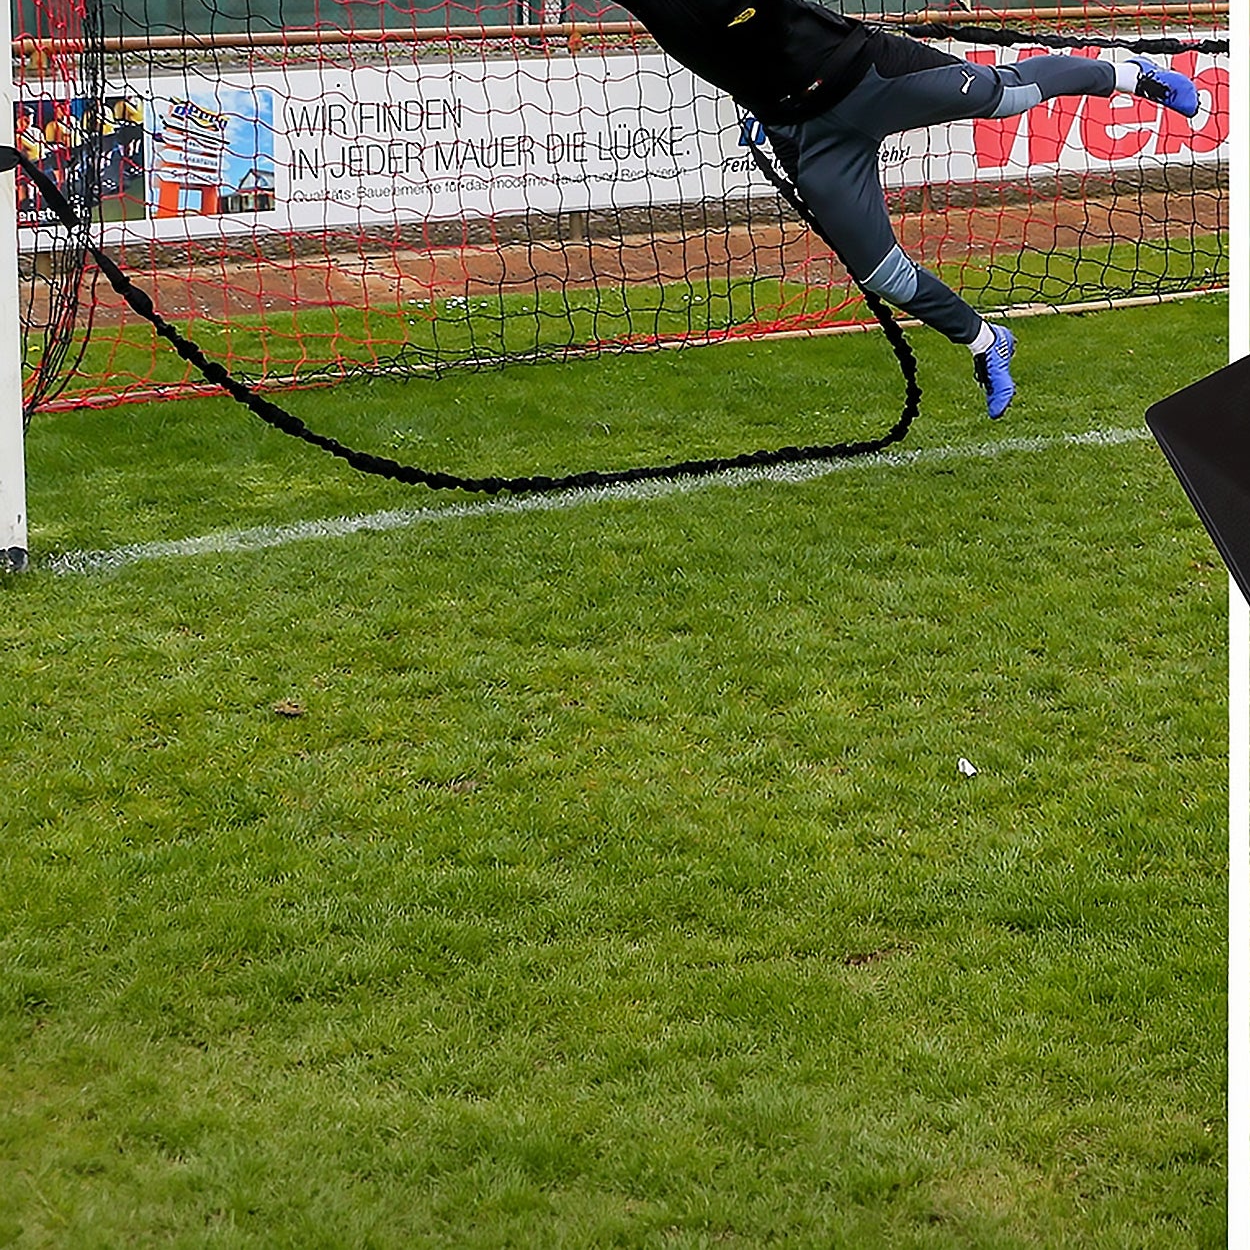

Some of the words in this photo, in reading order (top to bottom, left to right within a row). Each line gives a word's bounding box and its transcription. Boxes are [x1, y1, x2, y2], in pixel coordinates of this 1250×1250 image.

[290, 104, 347, 137] WIR
[359, 98, 462, 133] FINDEN
[292, 148, 319, 180] IN
[330, 142, 423, 178] JEDER
[434, 136, 535, 171] MAUER
[547, 132, 587, 164] DIE
[599, 124, 690, 161] LÜCKE.
[877, 145, 911, 163] ehr!
